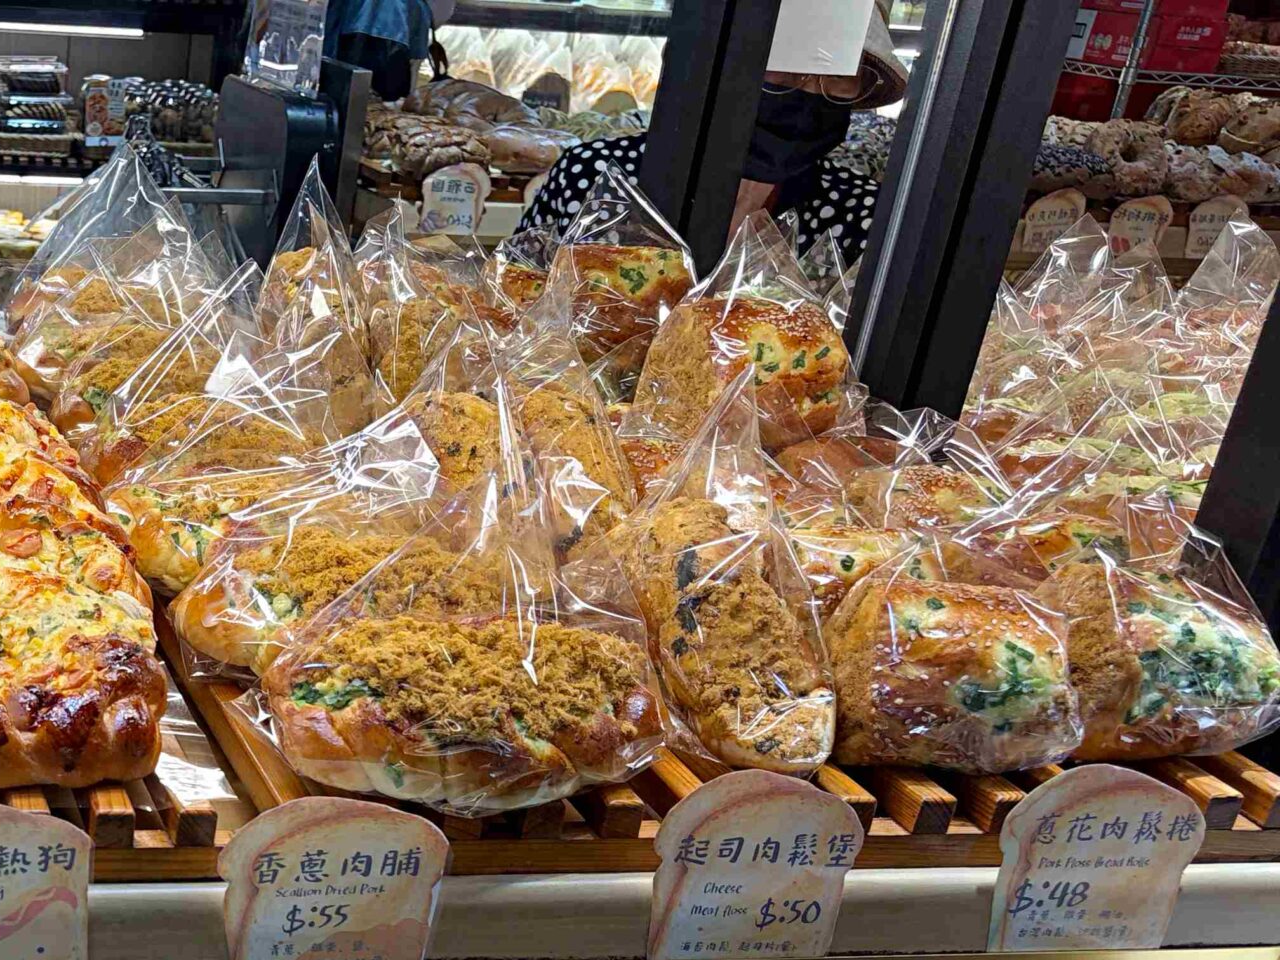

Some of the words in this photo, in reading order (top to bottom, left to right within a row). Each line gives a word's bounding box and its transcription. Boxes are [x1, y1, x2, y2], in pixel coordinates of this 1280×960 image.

[674, 834, 856, 868] 起司肉鬆堡
[703, 881, 743, 895] Cheese
